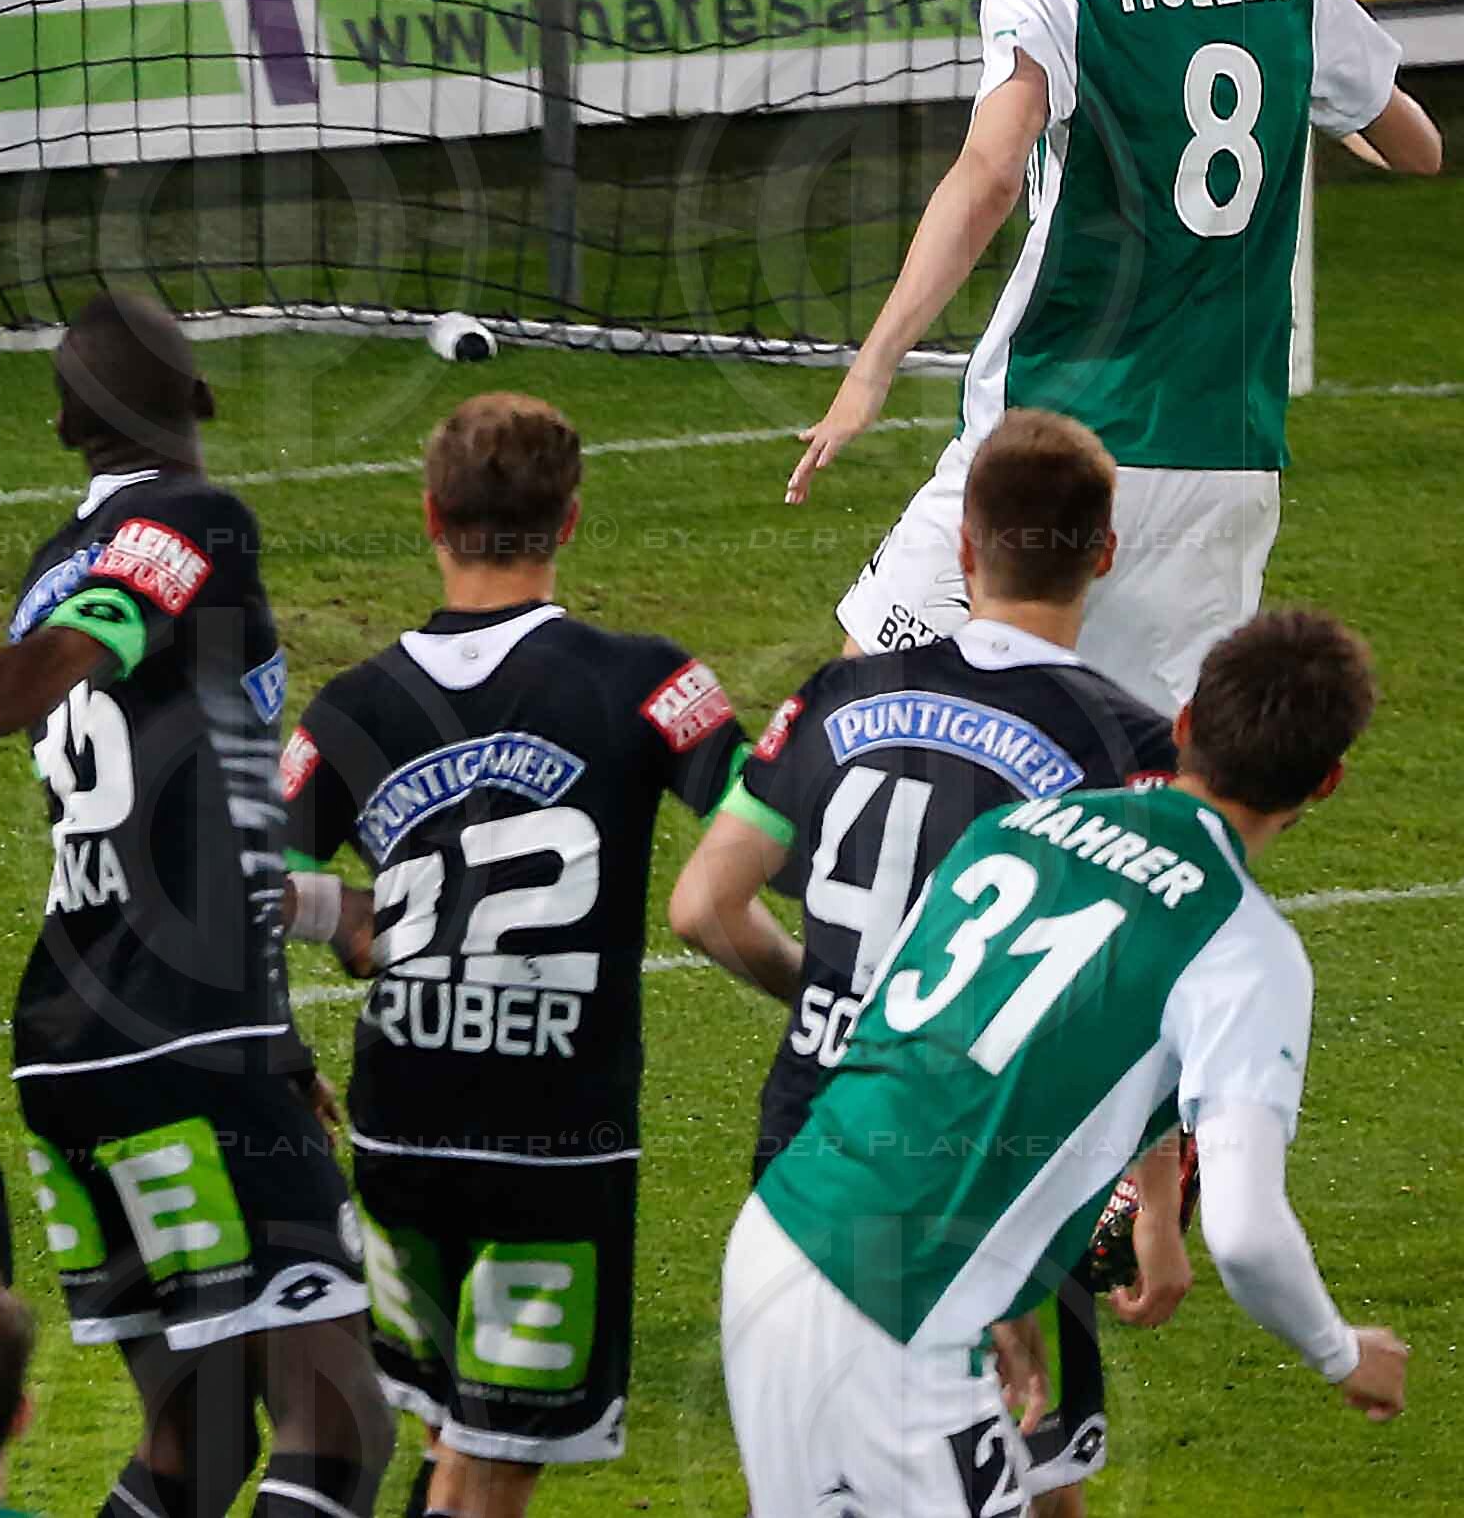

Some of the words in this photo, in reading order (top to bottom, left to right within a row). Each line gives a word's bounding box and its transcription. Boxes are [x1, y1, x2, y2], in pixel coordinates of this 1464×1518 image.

[1174, 42, 1264, 238] 8
[365, 743, 569, 847] PUNTIGAMER
[839, 698, 1070, 795] PUNTIGAMER
[373, 805, 601, 993] 22
[804, 766, 933, 994] 4
[1000, 797, 1206, 910] MAHRER
[883, 852, 1128, 1077] 31
